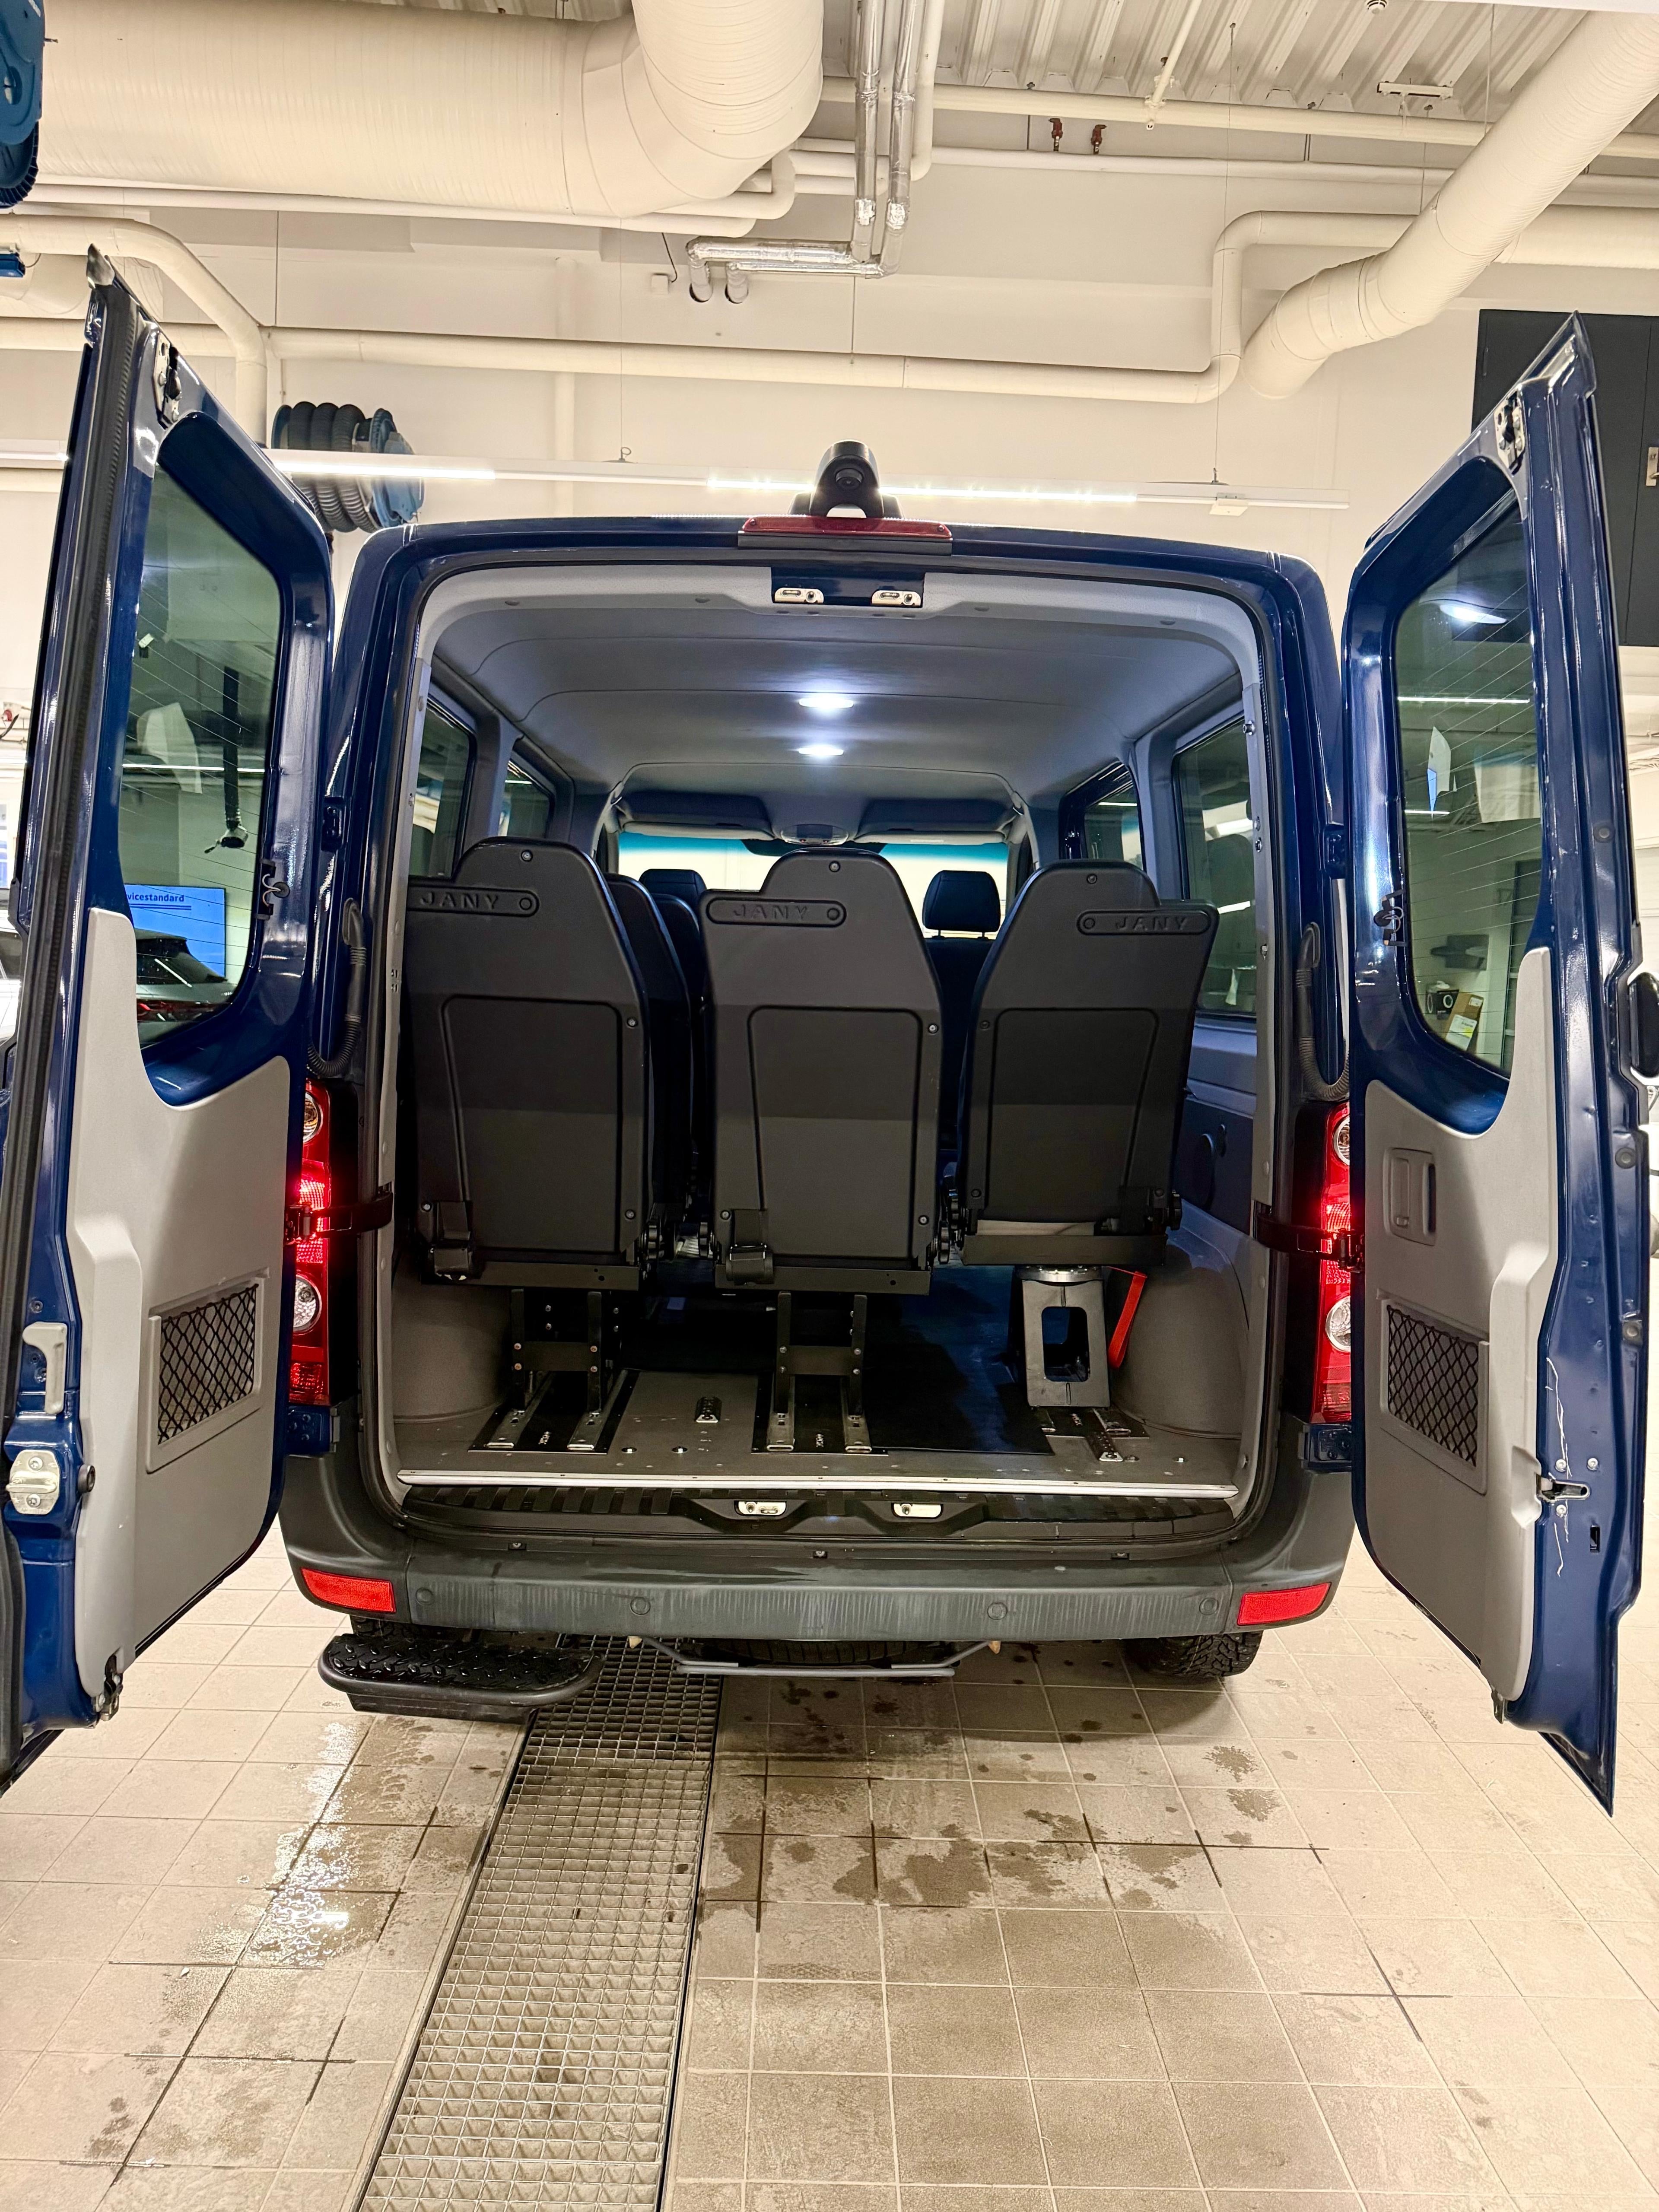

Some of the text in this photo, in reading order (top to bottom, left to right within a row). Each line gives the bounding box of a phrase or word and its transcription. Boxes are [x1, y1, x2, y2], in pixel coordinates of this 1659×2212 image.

[420, 891, 498, 909] JANY
[733, 904, 807, 919] JANY
[1116, 916, 1188, 930] JANY
